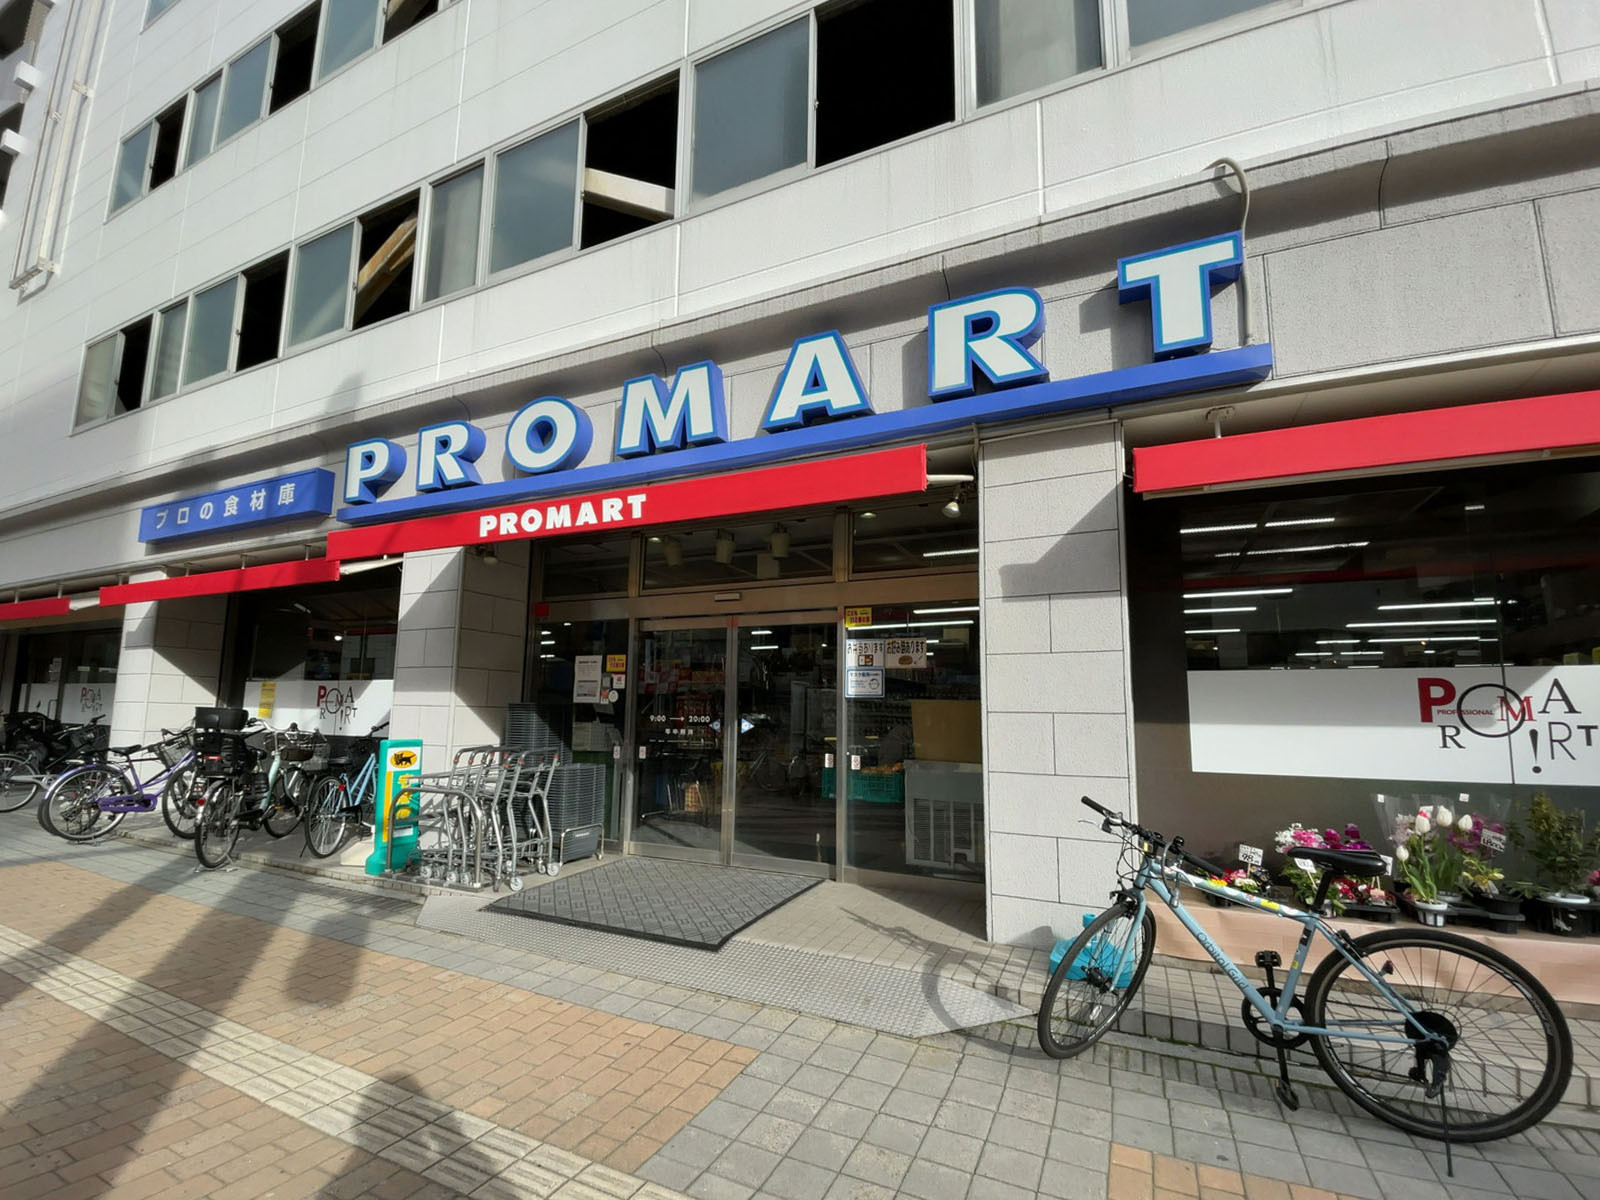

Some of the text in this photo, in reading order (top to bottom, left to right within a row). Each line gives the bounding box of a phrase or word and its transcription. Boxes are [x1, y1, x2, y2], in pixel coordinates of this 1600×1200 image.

[345, 231, 1243, 504] PROMART
[155, 482, 296, 529] プロの食材庫
[479, 493, 646, 537] PROMART
[1197, 932, 1230, 970] Orbital
